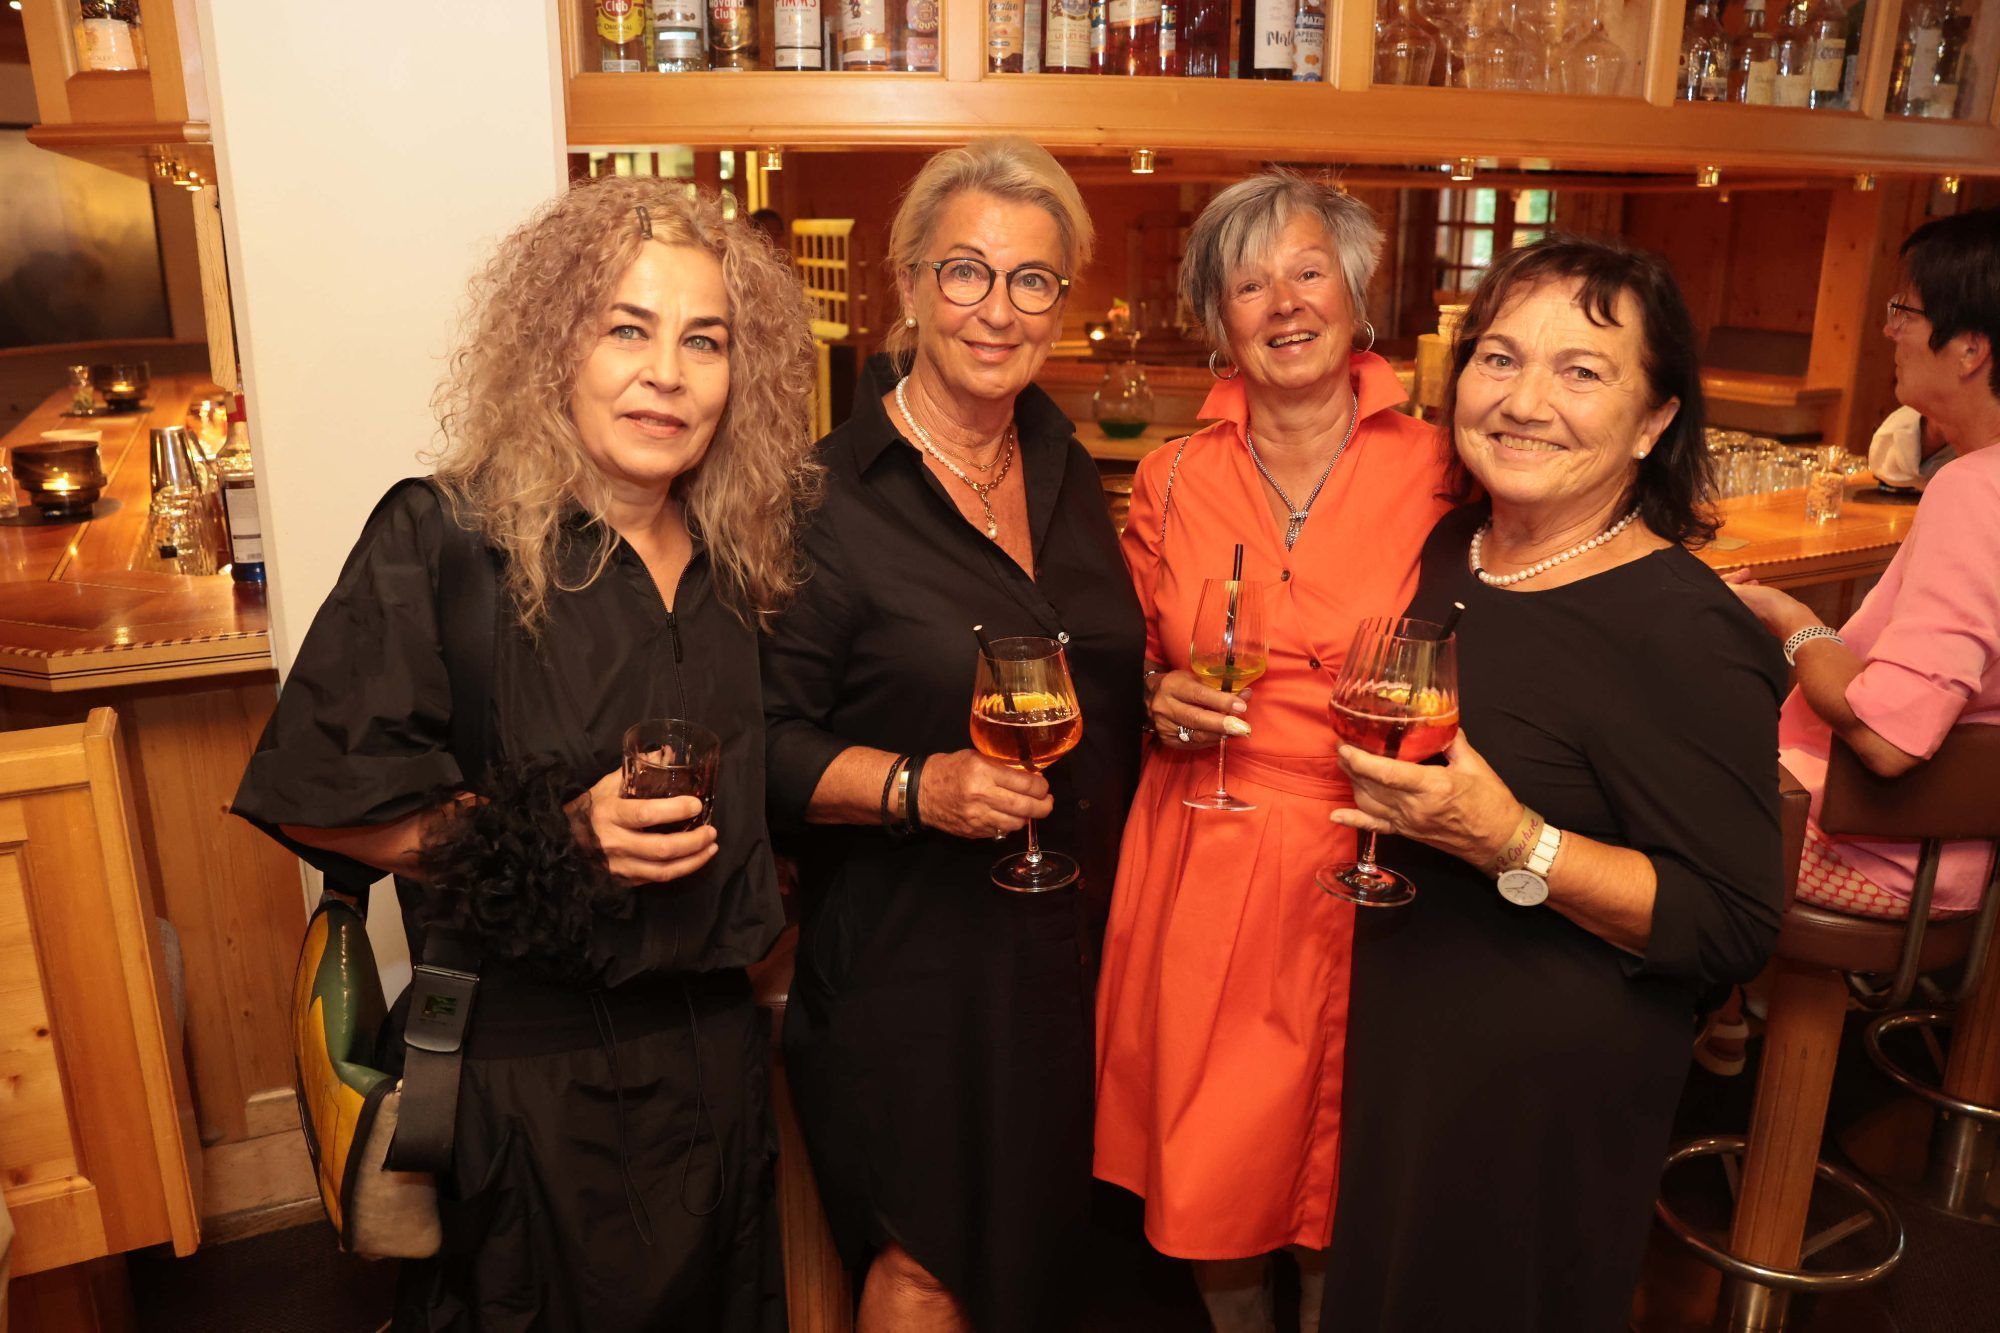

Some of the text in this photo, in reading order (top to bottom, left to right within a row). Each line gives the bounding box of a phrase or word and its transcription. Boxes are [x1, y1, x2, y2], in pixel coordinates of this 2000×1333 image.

[605, 0, 629, 13] Club
[776, 0, 817, 8] PIMMS
[714, 8, 737, 19] Club
[603, 23, 632, 32] ORIGNAL
